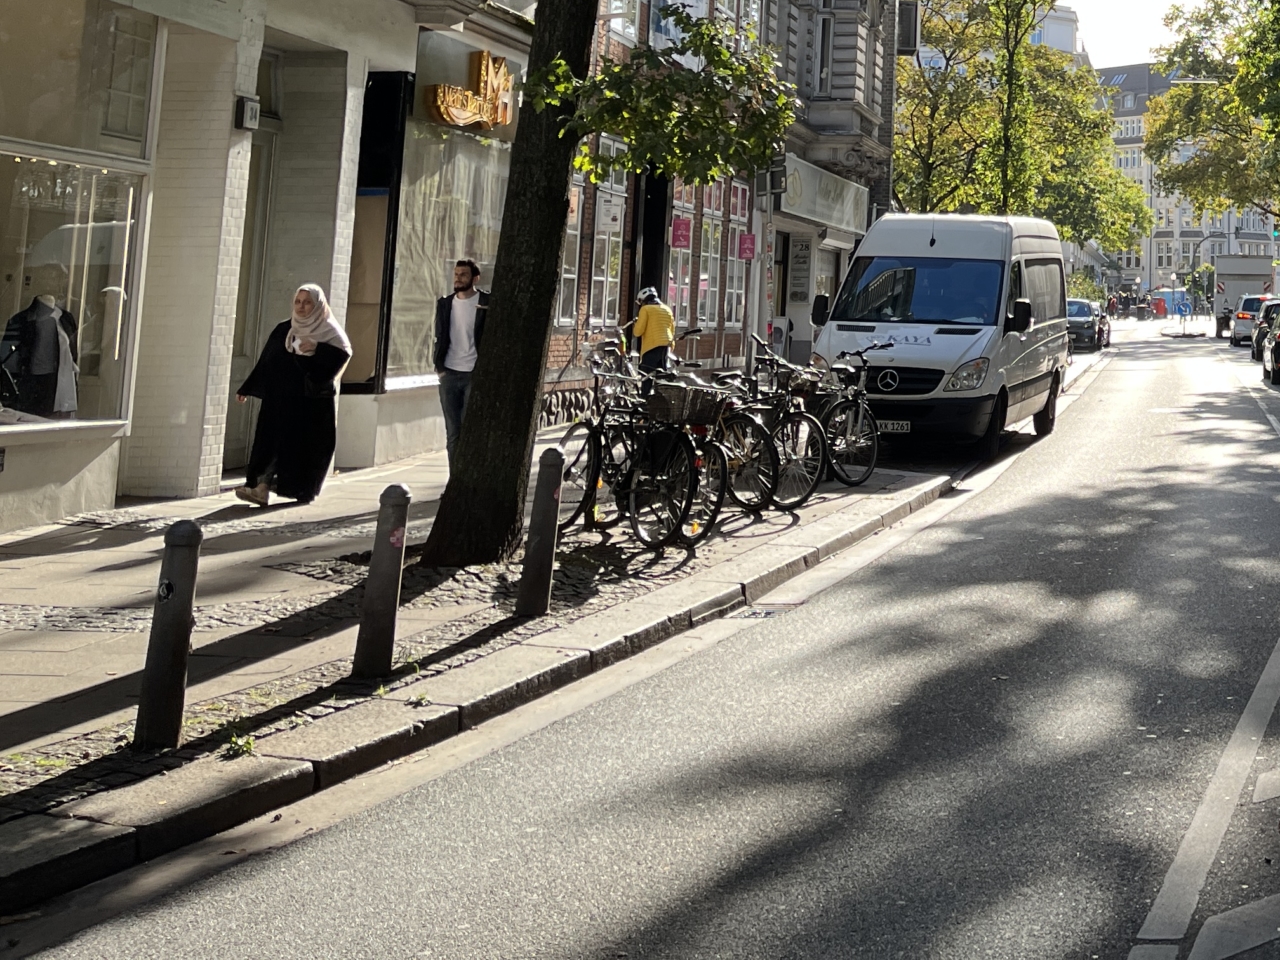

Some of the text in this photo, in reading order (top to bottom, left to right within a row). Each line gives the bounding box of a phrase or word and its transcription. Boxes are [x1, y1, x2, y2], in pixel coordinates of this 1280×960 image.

[799, 243, 810, 252] 28
[887, 334, 932, 344] KAYA
[890, 422, 909, 431] 1261
